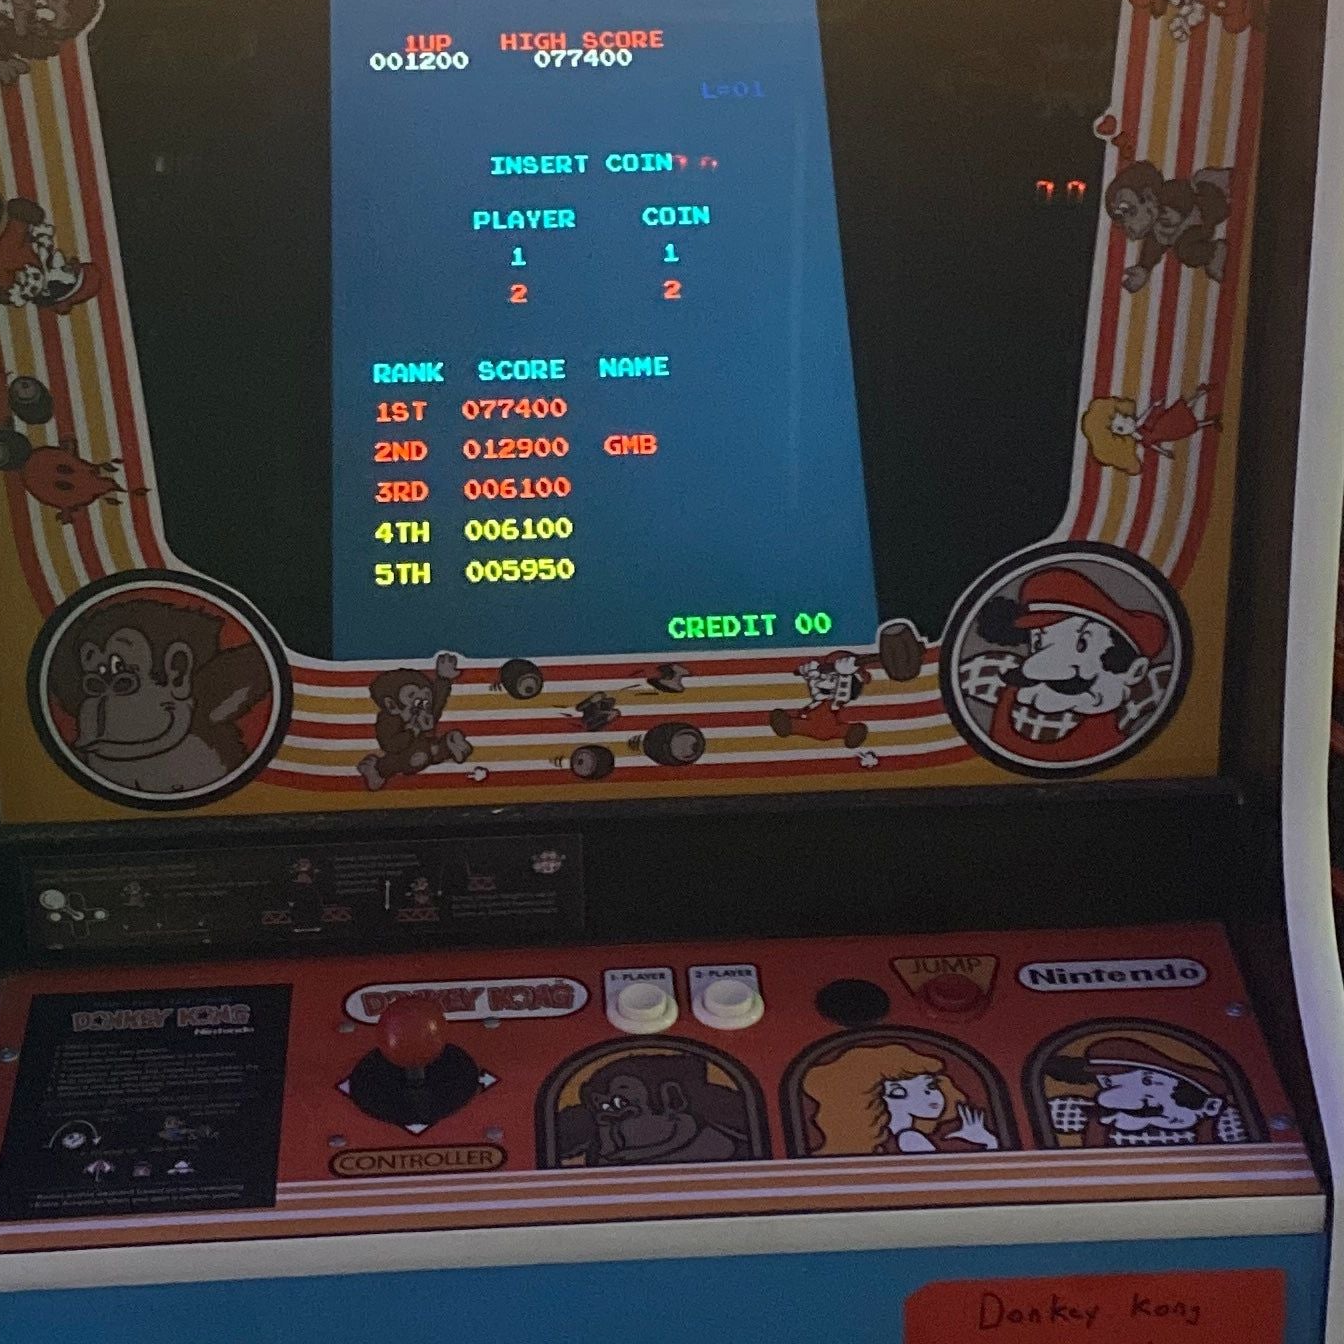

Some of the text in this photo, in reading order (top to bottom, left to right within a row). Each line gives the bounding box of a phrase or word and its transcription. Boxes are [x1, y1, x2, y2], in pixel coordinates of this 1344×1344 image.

[405, 33, 452, 54] 1UP
[500, 29, 665, 52] HIGH SCORE
[369, 51, 470, 72] 001200
[533, 49, 634, 69] 077400
[490, 152, 673, 176] INSERT COIN
[473, 205, 711, 231] PLAYER COIN
[511, 243, 681, 267] 1 1
[510, 279, 683, 303] 2 2
[373, 356, 671, 384] RANK SCORE NAME
[376, 397, 569, 424] 1ST 077400
[374, 433, 658, 463] 2ND 012900 GMB
[375, 477, 573, 504] 3RD 006100
[375, 517, 574, 545] 4TH 006100
[375, 558, 576, 586] 5TH 005950
[668, 611, 833, 640] CREDIT 00
[622, 972, 667, 981] PLAYER
[708, 969, 753, 978] PLAYER
[910, 957, 982, 975] JUMP
[1027, 962, 1201, 986] Nintendo
[487, 983, 575, 1012] KONG
[71, 1003, 252, 1033] DONKEY KONG
[339, 1149, 495, 1173] CONTROLLER
[978, 1290, 1202, 1330] Donkey Kong
